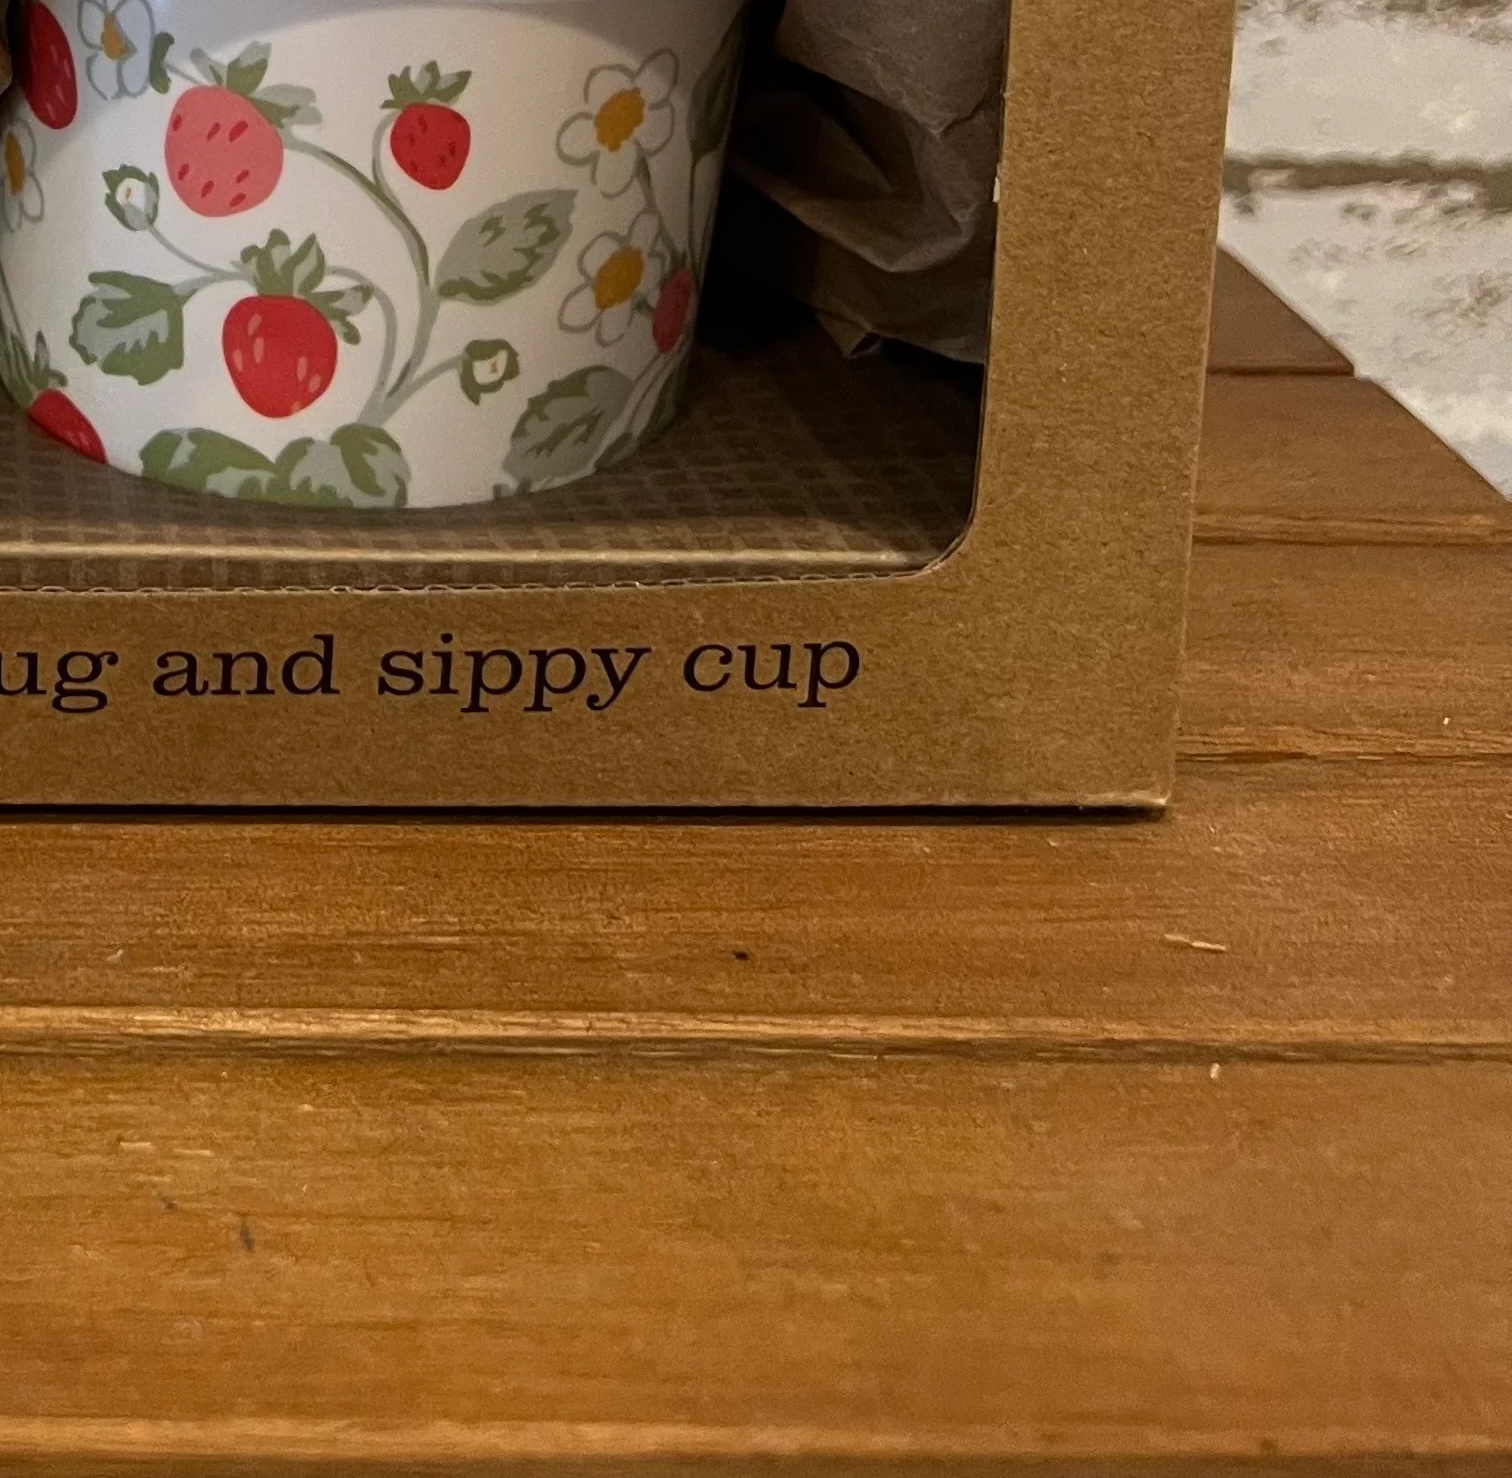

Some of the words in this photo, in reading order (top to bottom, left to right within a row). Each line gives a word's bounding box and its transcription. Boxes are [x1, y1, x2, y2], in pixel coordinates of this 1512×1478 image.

[153, 634, 340, 697] and
[378, 633, 652, 713] sippy
[683, 641, 859, 708] cup
